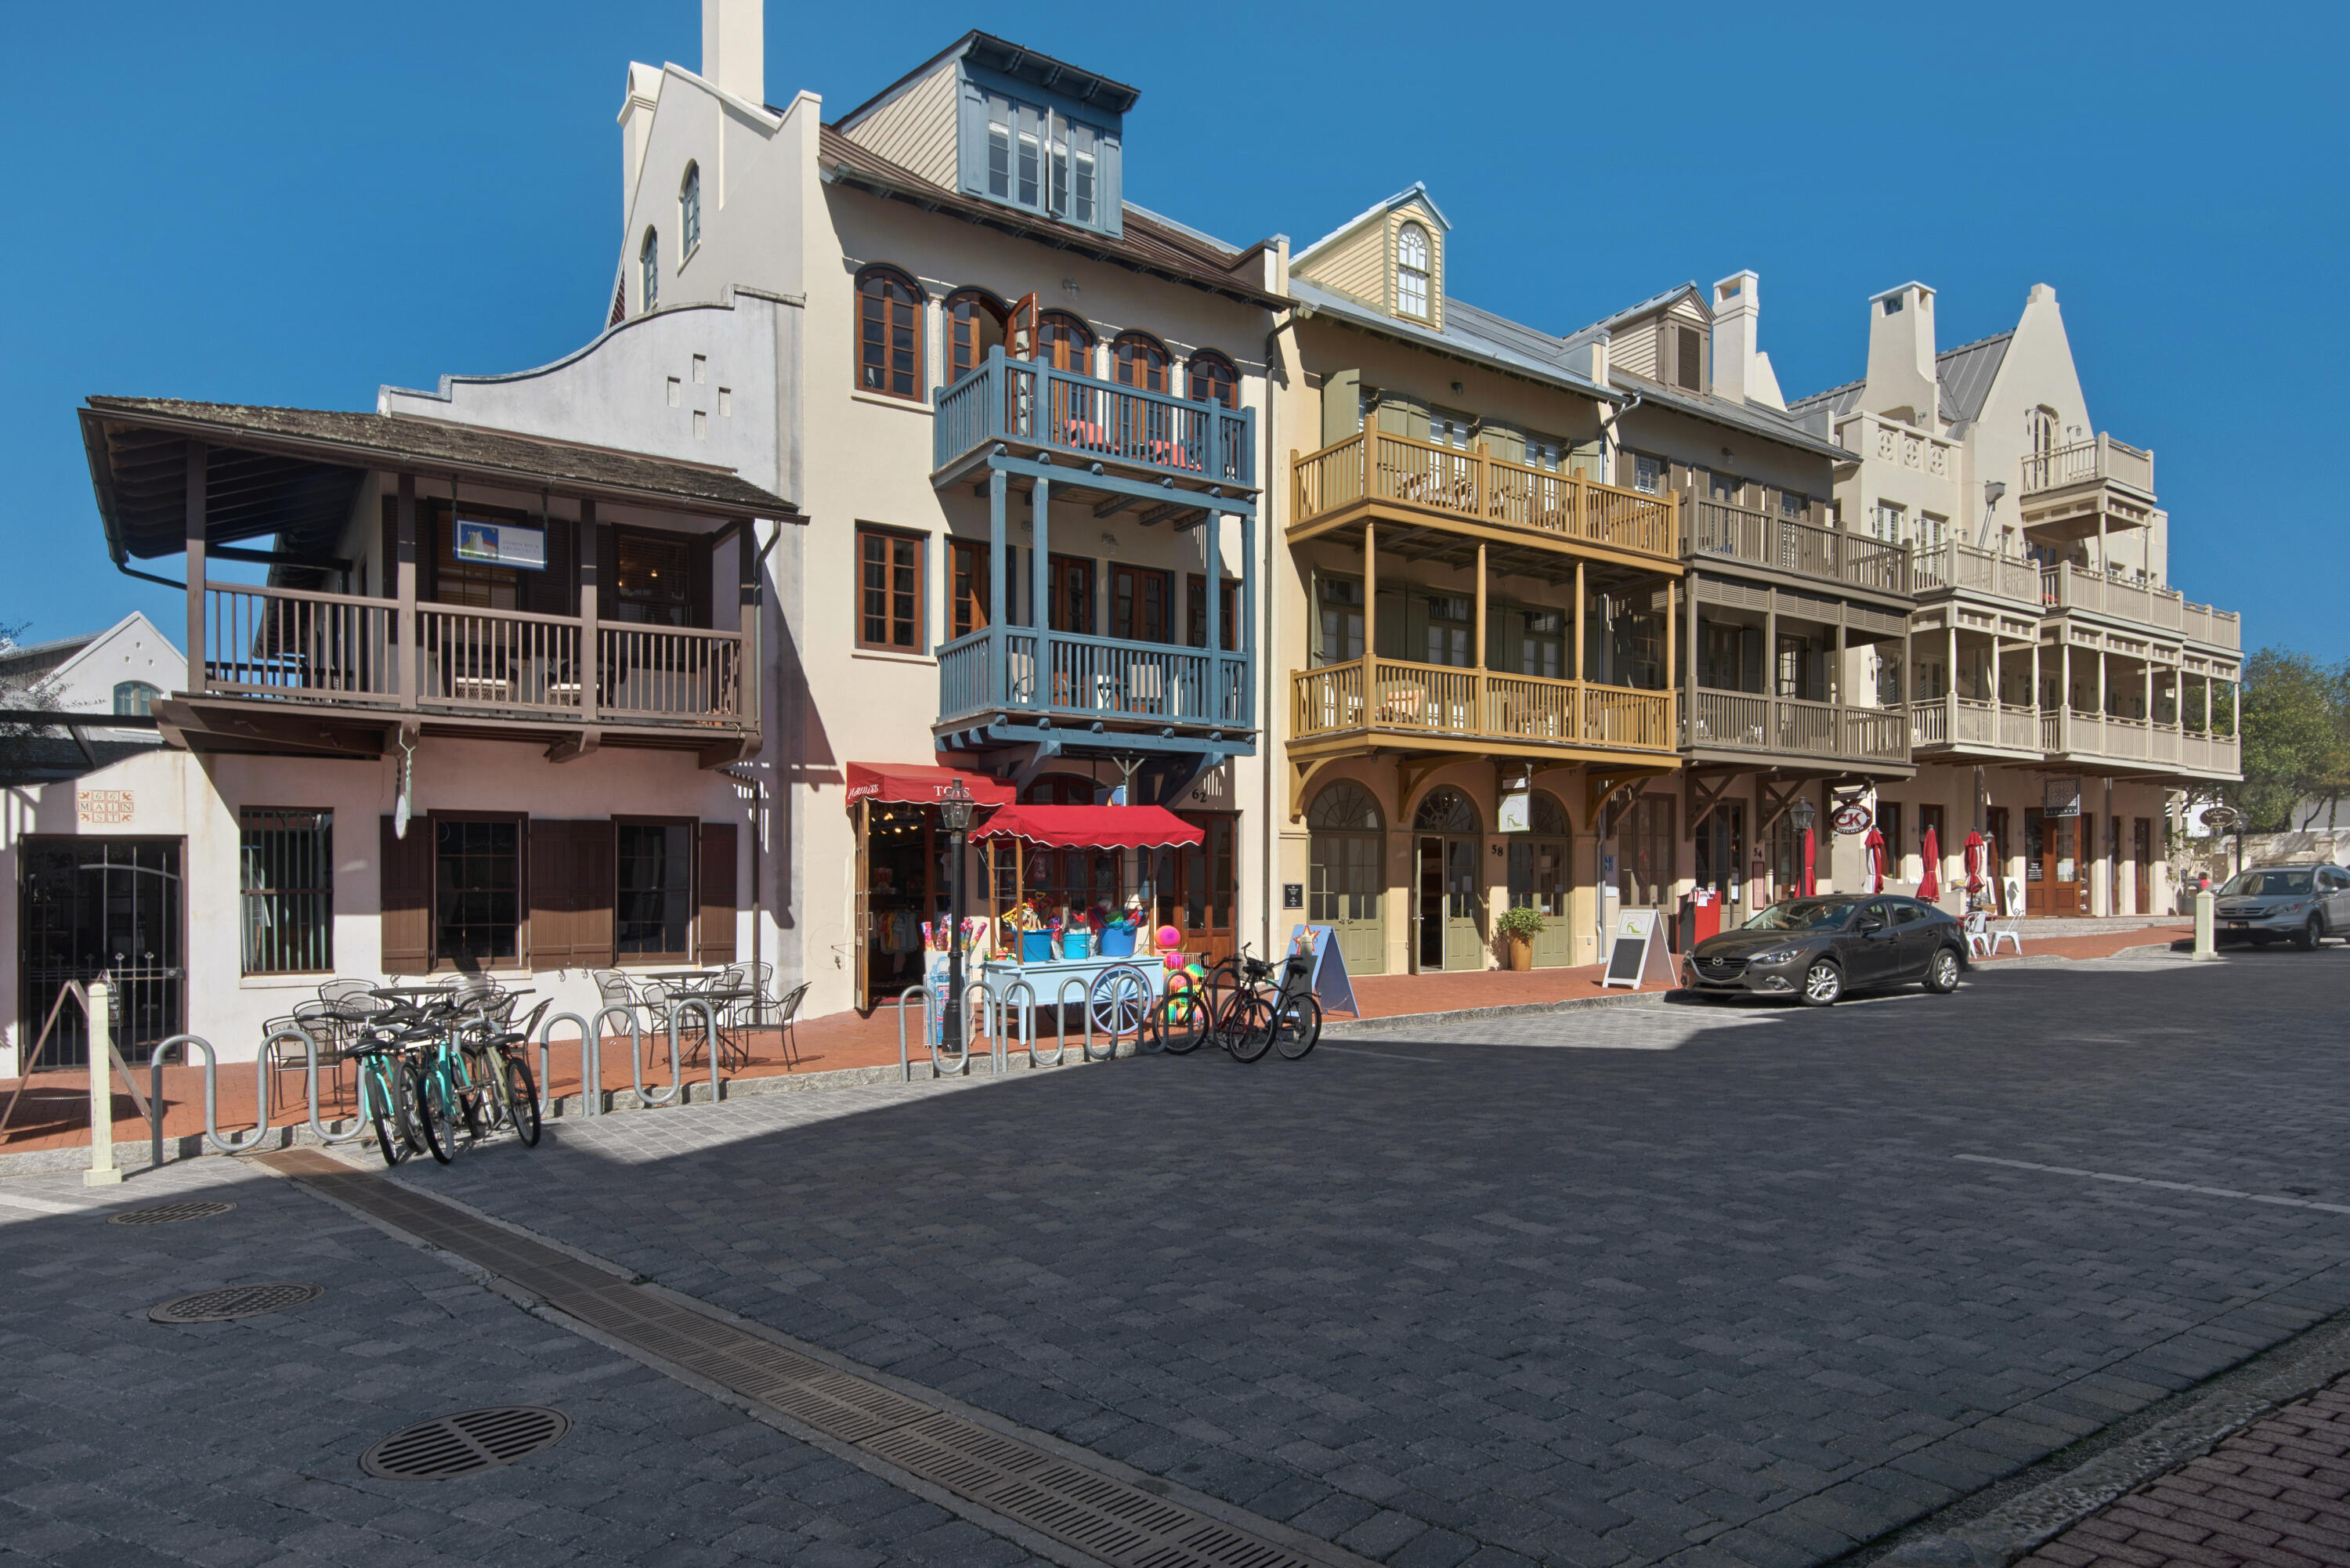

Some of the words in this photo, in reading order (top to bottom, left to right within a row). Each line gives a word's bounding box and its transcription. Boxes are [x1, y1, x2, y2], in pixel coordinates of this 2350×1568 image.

[1191, 788, 1207, 803] 62
[1835, 812, 1862, 826] CK
[1491, 844, 1503, 857] 58
[1754, 847, 1762, 858] 54
